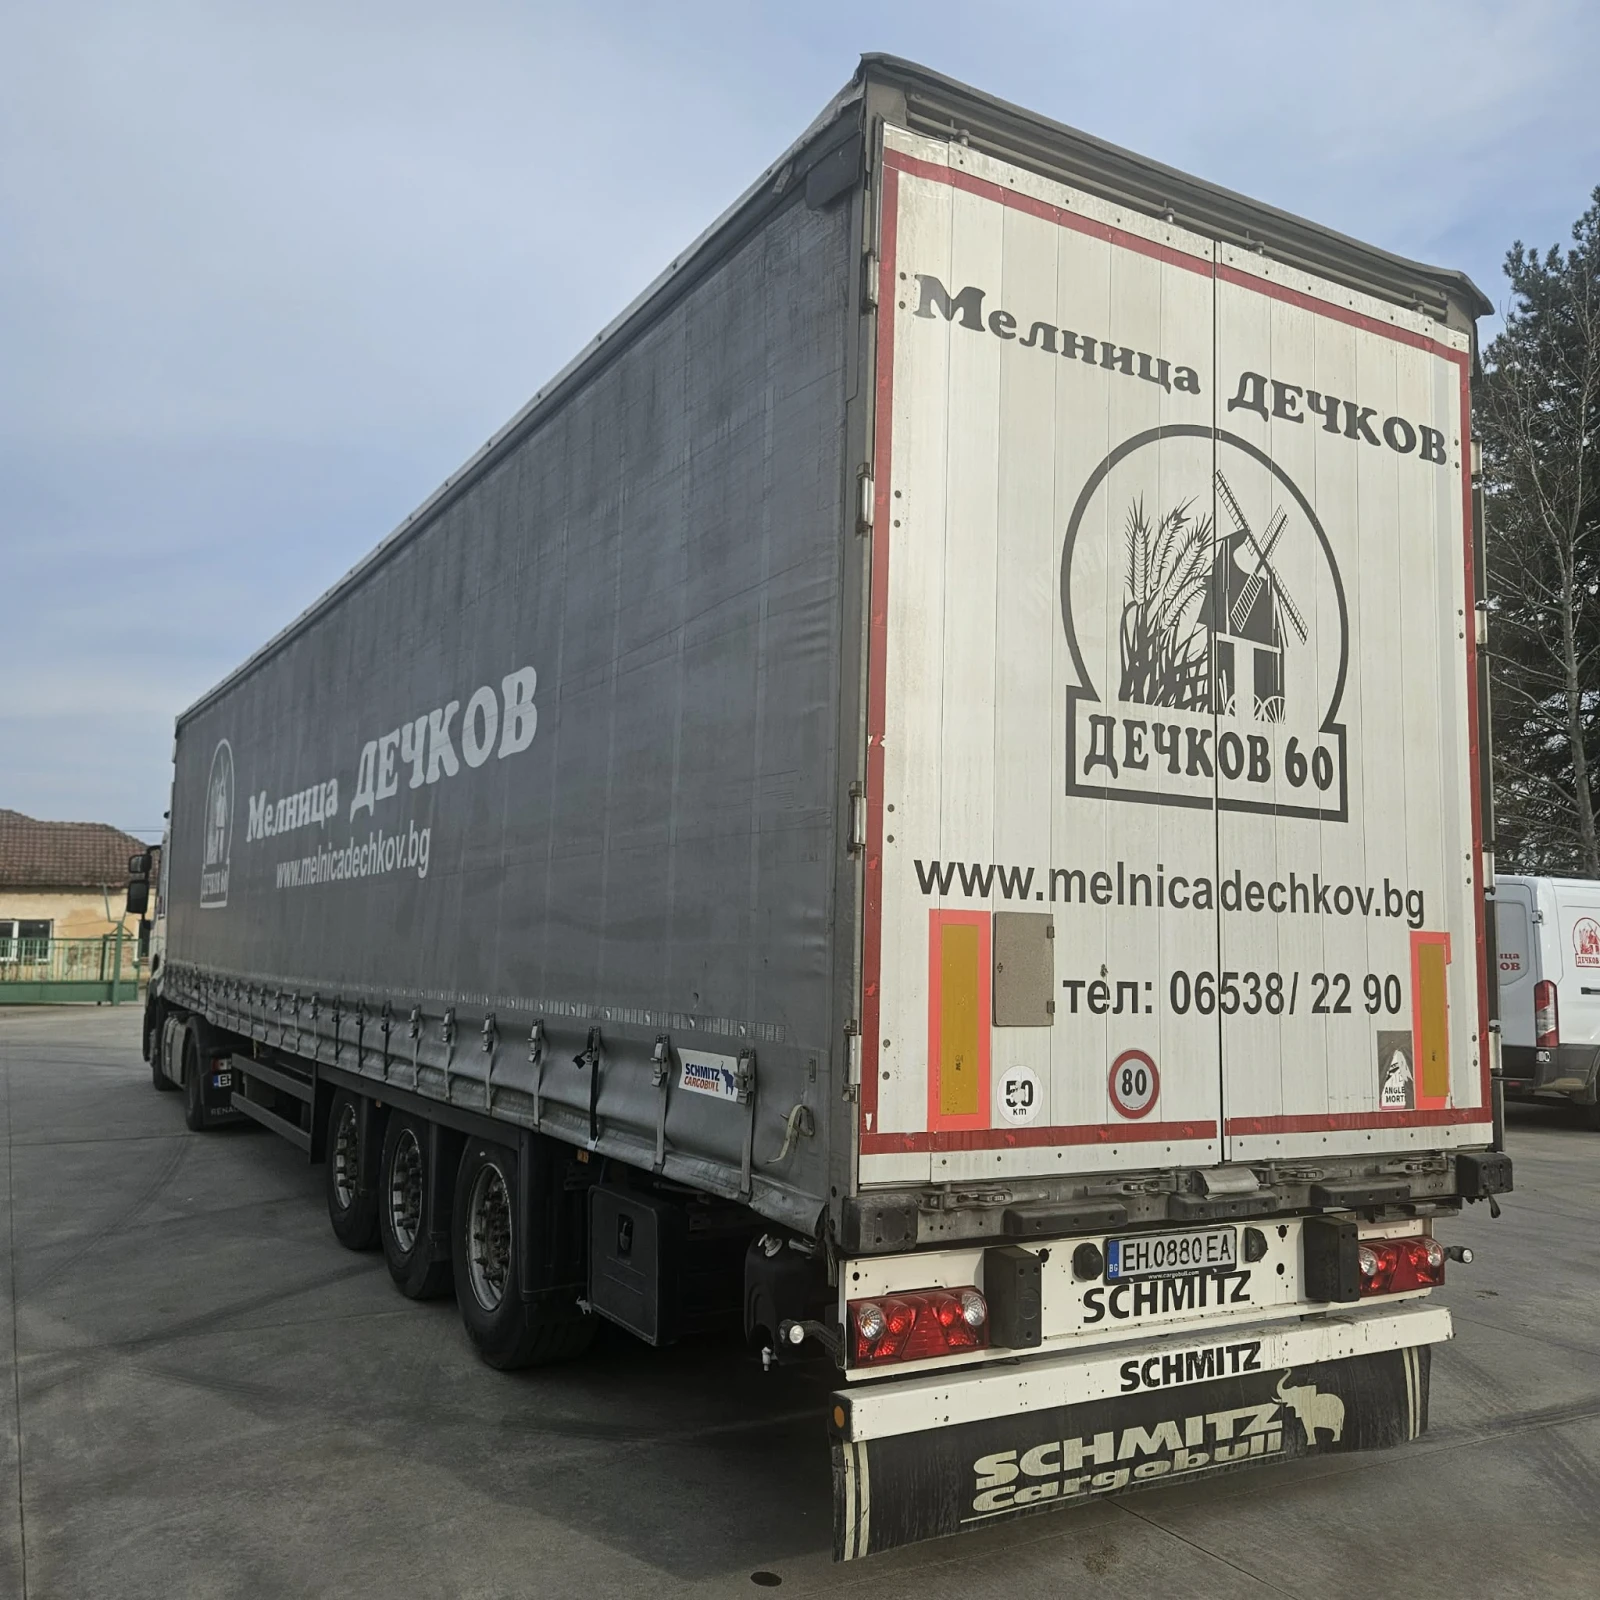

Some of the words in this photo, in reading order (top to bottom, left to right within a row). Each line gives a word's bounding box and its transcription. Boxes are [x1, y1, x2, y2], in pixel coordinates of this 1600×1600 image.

[912, 273, 1201, 395] Мелница
[1227, 370, 1448, 466] ДЕЧКОВ
[246, 778, 338, 843] Мелница
[350, 666, 538, 824] ДЕЧКОВ
[1083, 713, 1272, 784] ДЕЧКОВ
[1285, 735, 1334, 791] 60
[276, 819, 432, 890] www.melnicadechkov.bg
[914, 859, 1426, 930] www.melnicadechkov.bg
[1062, 978, 1154, 1016] тел:
[1169, 969, 1299, 1017] 06538/
[1310, 971, 1353, 1015] 22
[1363, 971, 1403, 1015] 90
[685, 1063, 720, 1081] SCHMITZ
[1005, 1079, 1034, 1108] 50
[1121, 1068, 1147, 1096] 80
[1385, 1094, 1406, 1104] MORT
[1108, 1263, 1119, 1273] BG
[1147, 1270, 1200, 1280] www.cargobull.com
[1083, 1270, 1252, 1324] SCHMITZ
[1120, 1341, 1262, 1393] SCHMITZ
[972, 1431, 1282, 1512] Cargobull
[973, 1402, 1284, 1490] SCHMITZ
